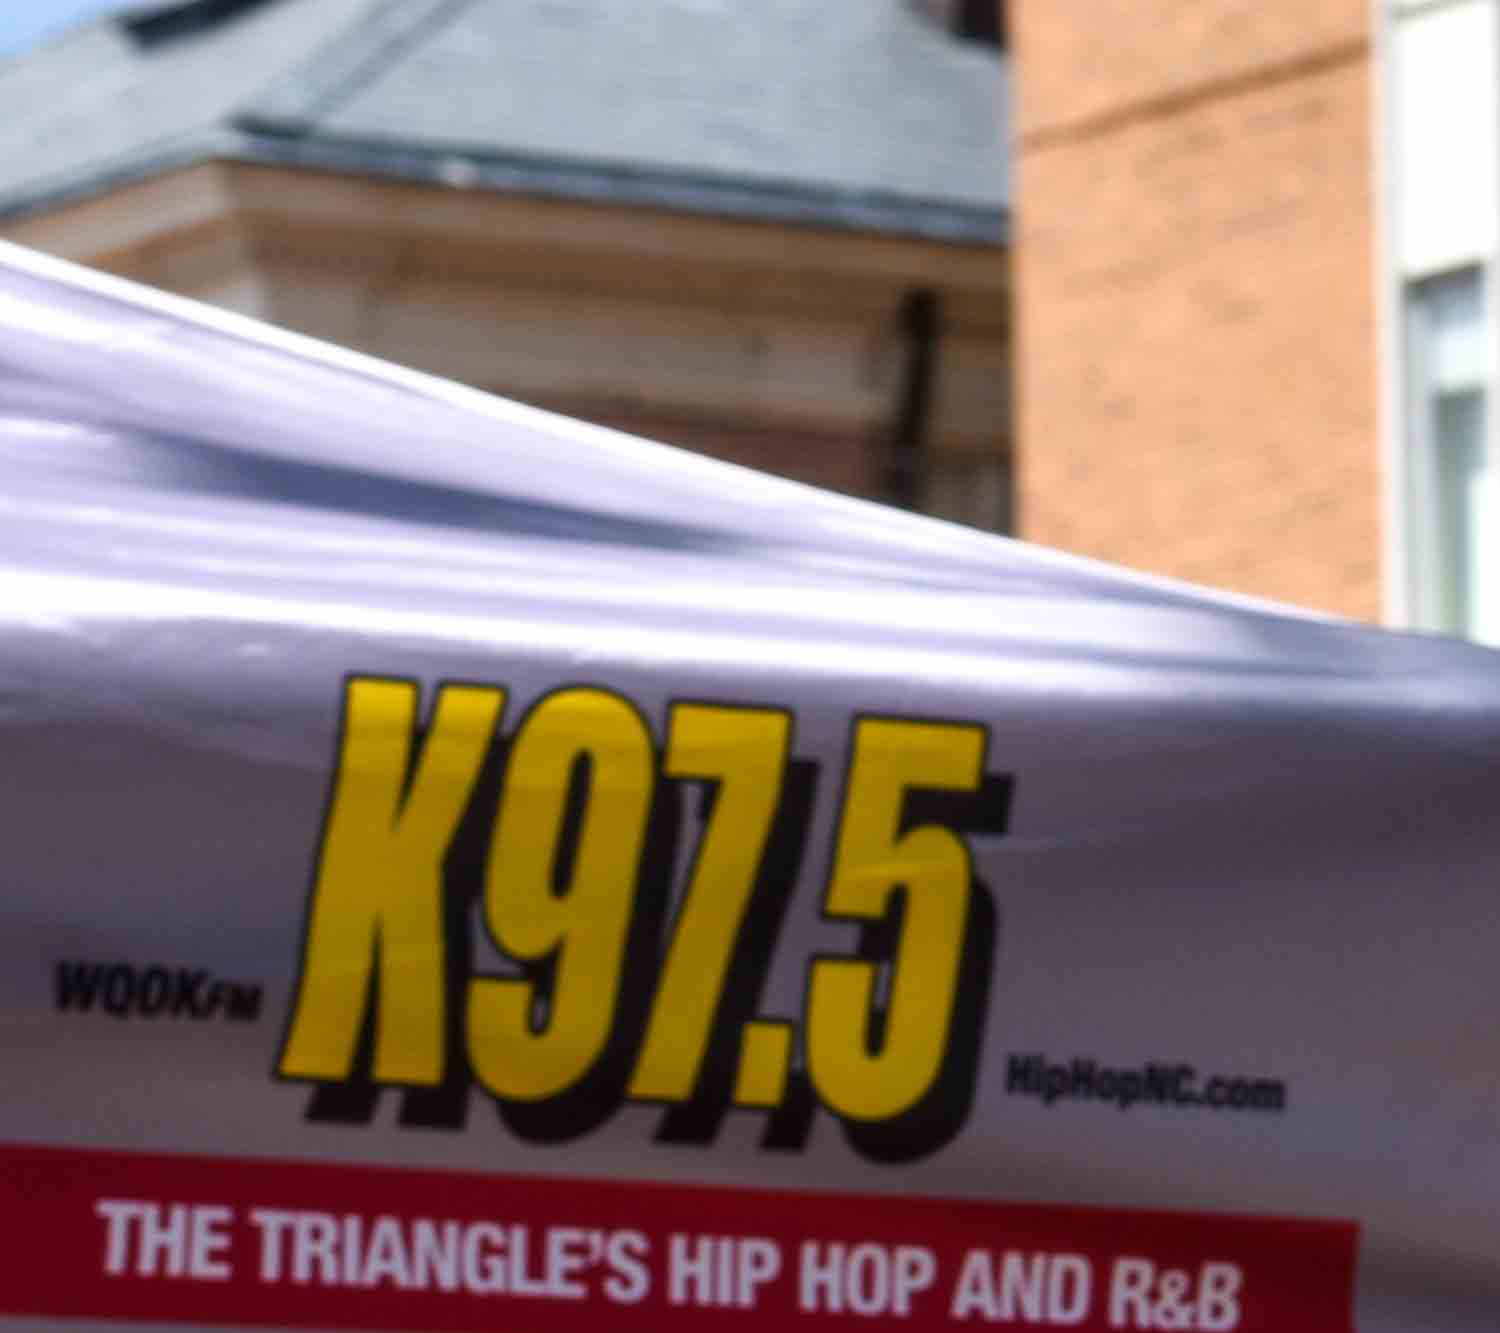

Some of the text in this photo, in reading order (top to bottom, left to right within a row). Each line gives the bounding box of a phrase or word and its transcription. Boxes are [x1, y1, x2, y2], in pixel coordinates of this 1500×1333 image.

[274, 674, 994, 1126] K97.5
[1006, 1053, 1287, 1111] HipHopNC.com
[95, 1198, 235, 1281] THE
[250, 1206, 651, 1306] TRIANGLE'S
[667, 1231, 781, 1309] HIP
[797, 1238, 937, 1318] HOP
[950, 1248, 1094, 1327] AND
